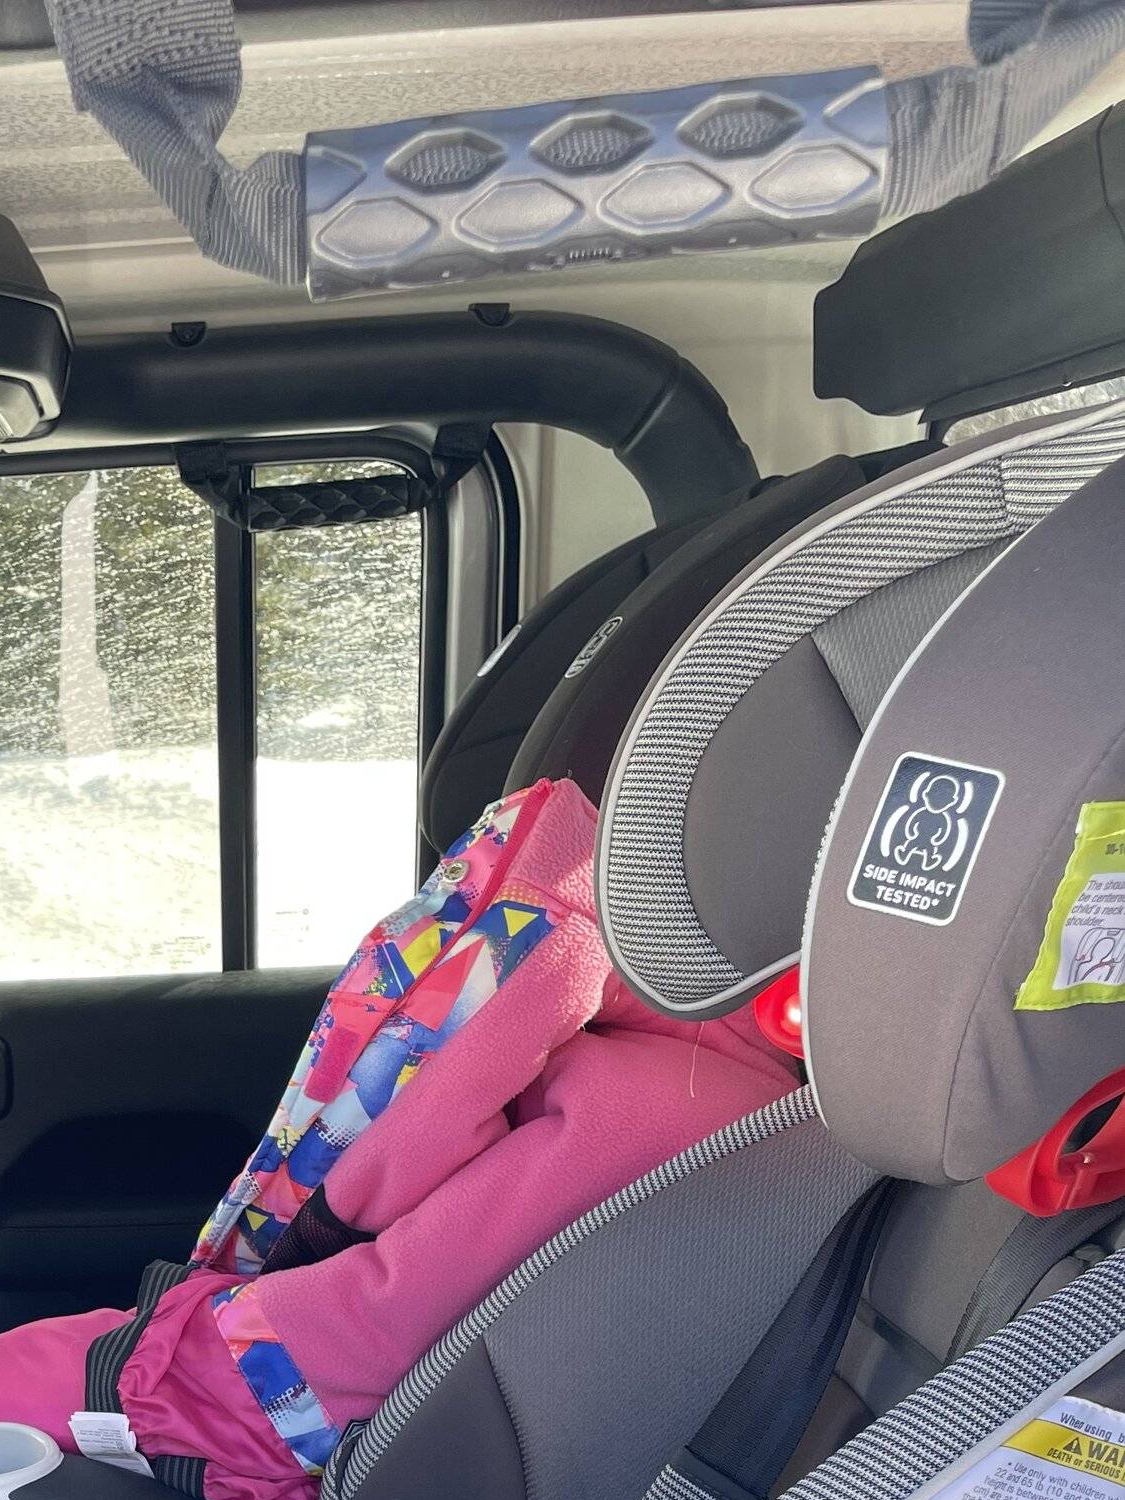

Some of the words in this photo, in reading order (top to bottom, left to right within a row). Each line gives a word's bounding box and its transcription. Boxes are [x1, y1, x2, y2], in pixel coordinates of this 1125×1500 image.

[862, 863, 899, 883] SIDE
[898, 872, 956, 897] IMPACT
[1083, 1423, 1112, 1440] using
[1047, 1448, 1071, 1462] DEATH
[1084, 1460, 1120, 1478] SERIOUS
[1046, 1485, 1062, 1497] (10
[1048, 1475, 1067, 1487] with
[1069, 1482, 1105, 1500] children
